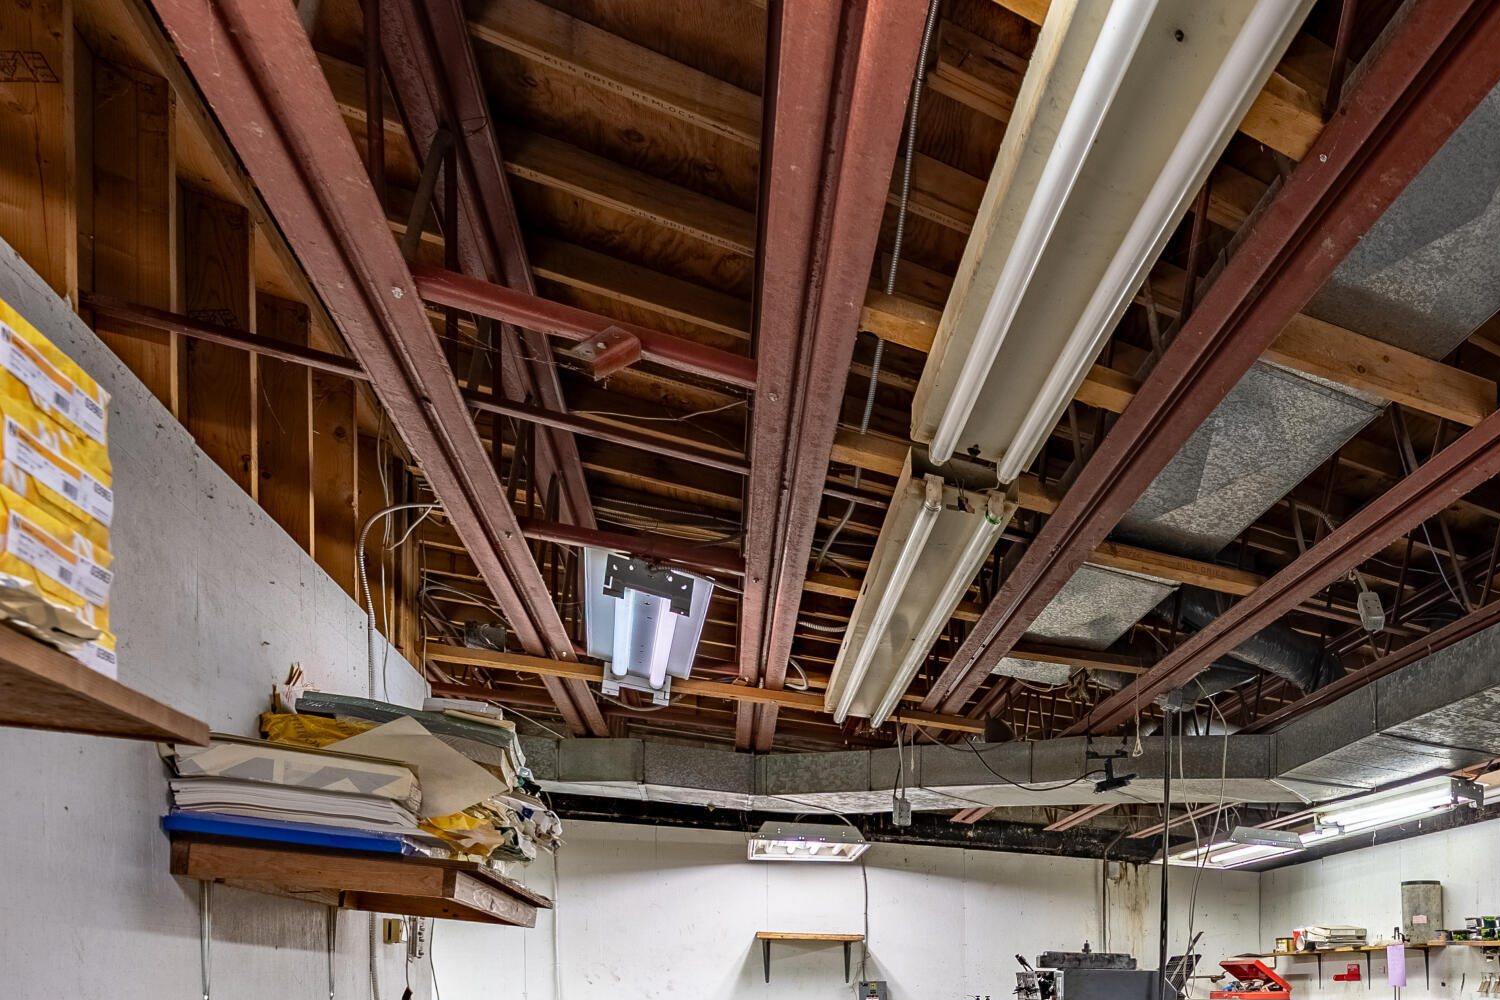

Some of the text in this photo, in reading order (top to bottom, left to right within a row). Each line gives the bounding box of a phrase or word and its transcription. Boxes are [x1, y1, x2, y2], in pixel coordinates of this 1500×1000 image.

[543, 55, 696, 121] KILN DRIED HEMLOCK
